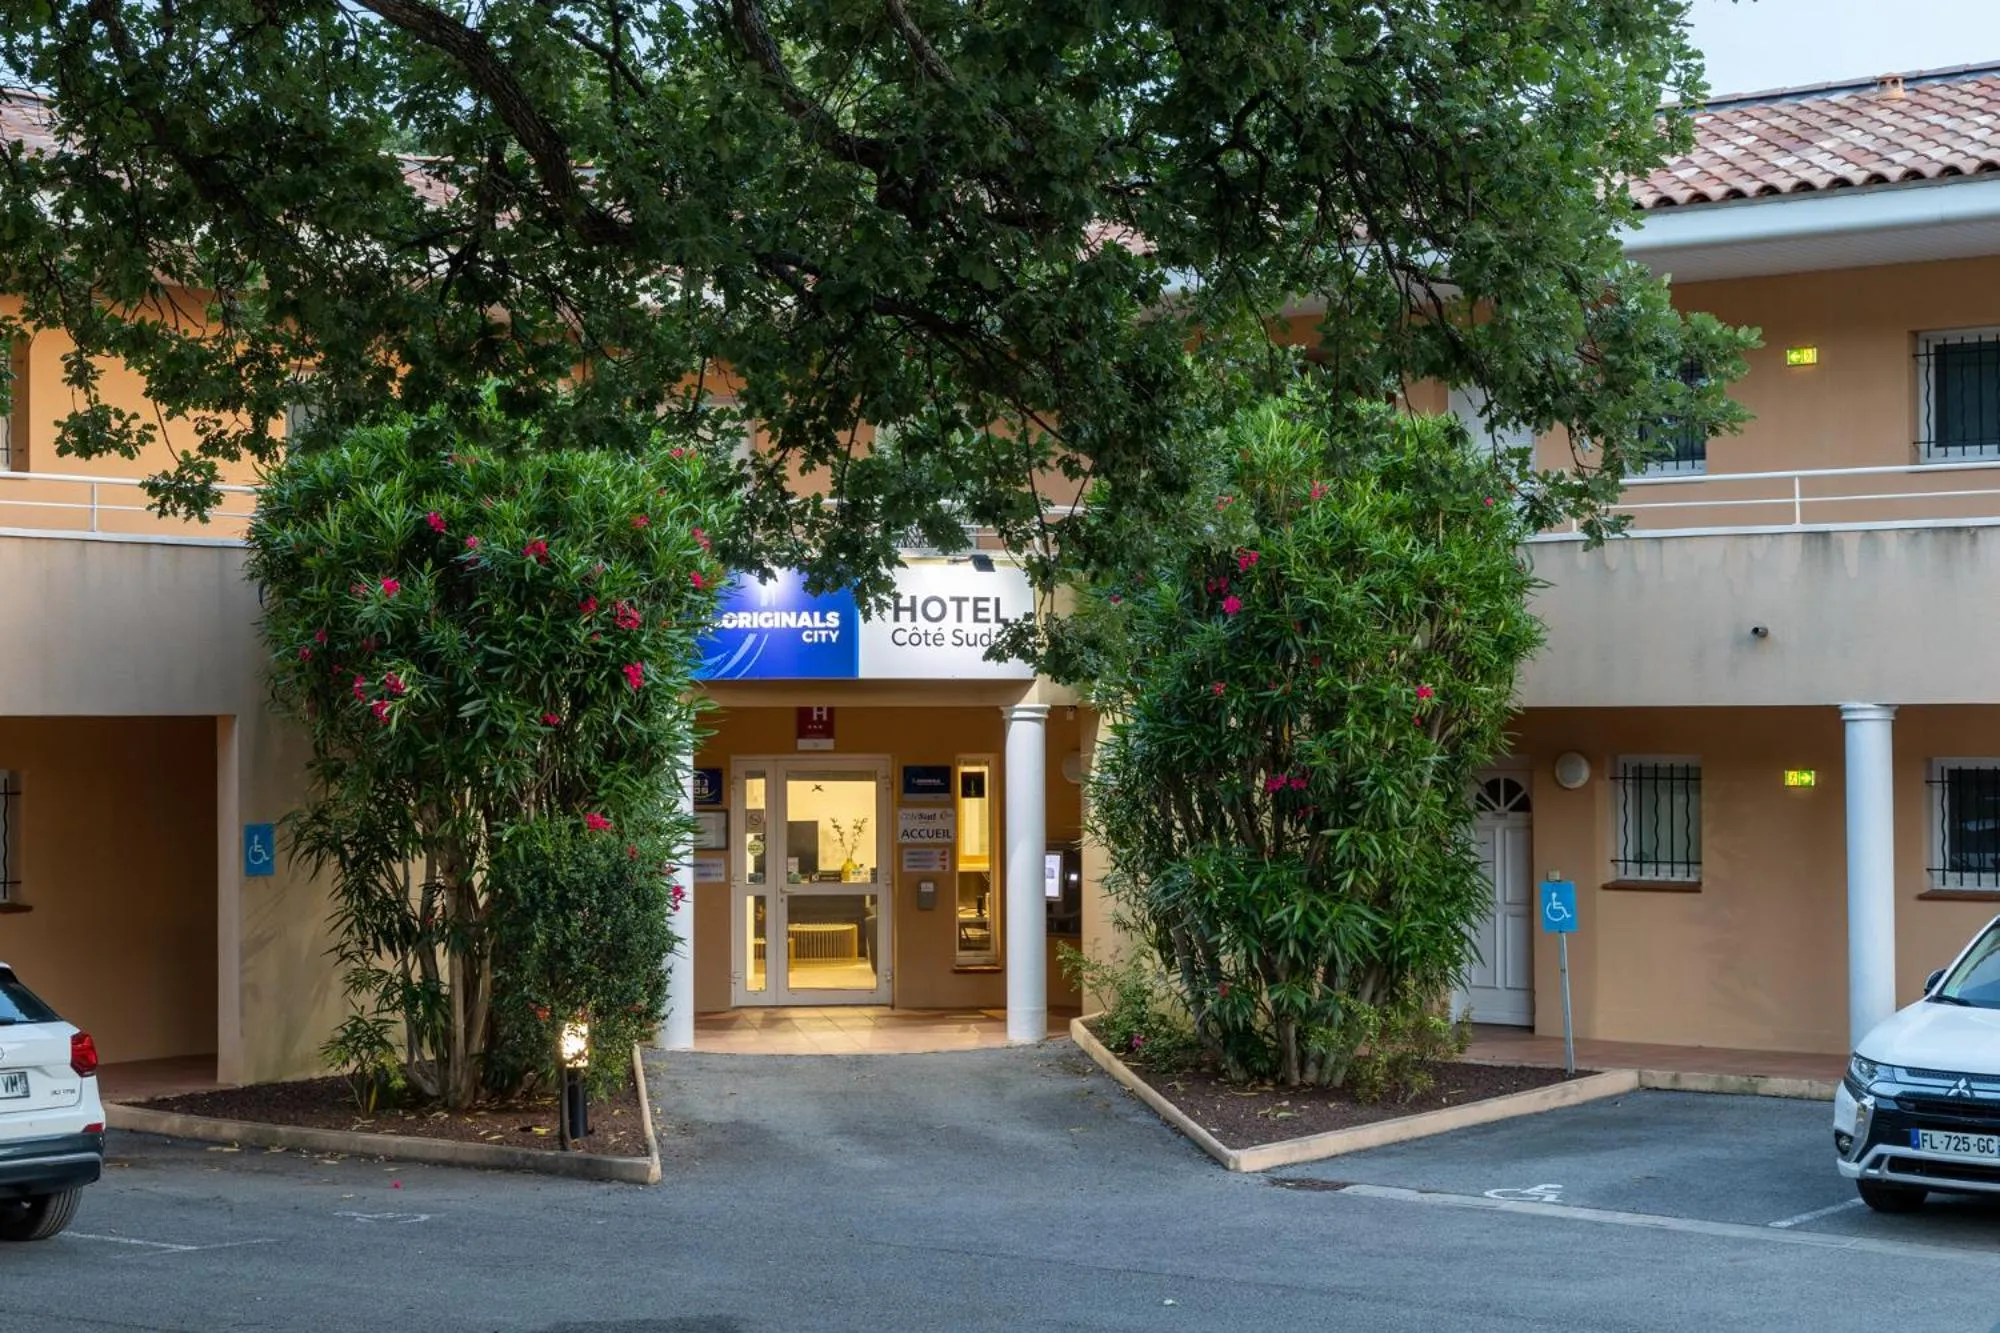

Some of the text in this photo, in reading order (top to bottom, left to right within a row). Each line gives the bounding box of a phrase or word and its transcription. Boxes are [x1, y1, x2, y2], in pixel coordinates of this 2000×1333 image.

[893, 595, 1009, 624] HOTEL
[722, 610, 840, 629] ORIGINALS
[802, 630, 840, 643] CITY
[891, 626, 992, 648] Côté Sud
[812, 706, 828, 721] H
[900, 828, 953, 840] ACCUEIL
